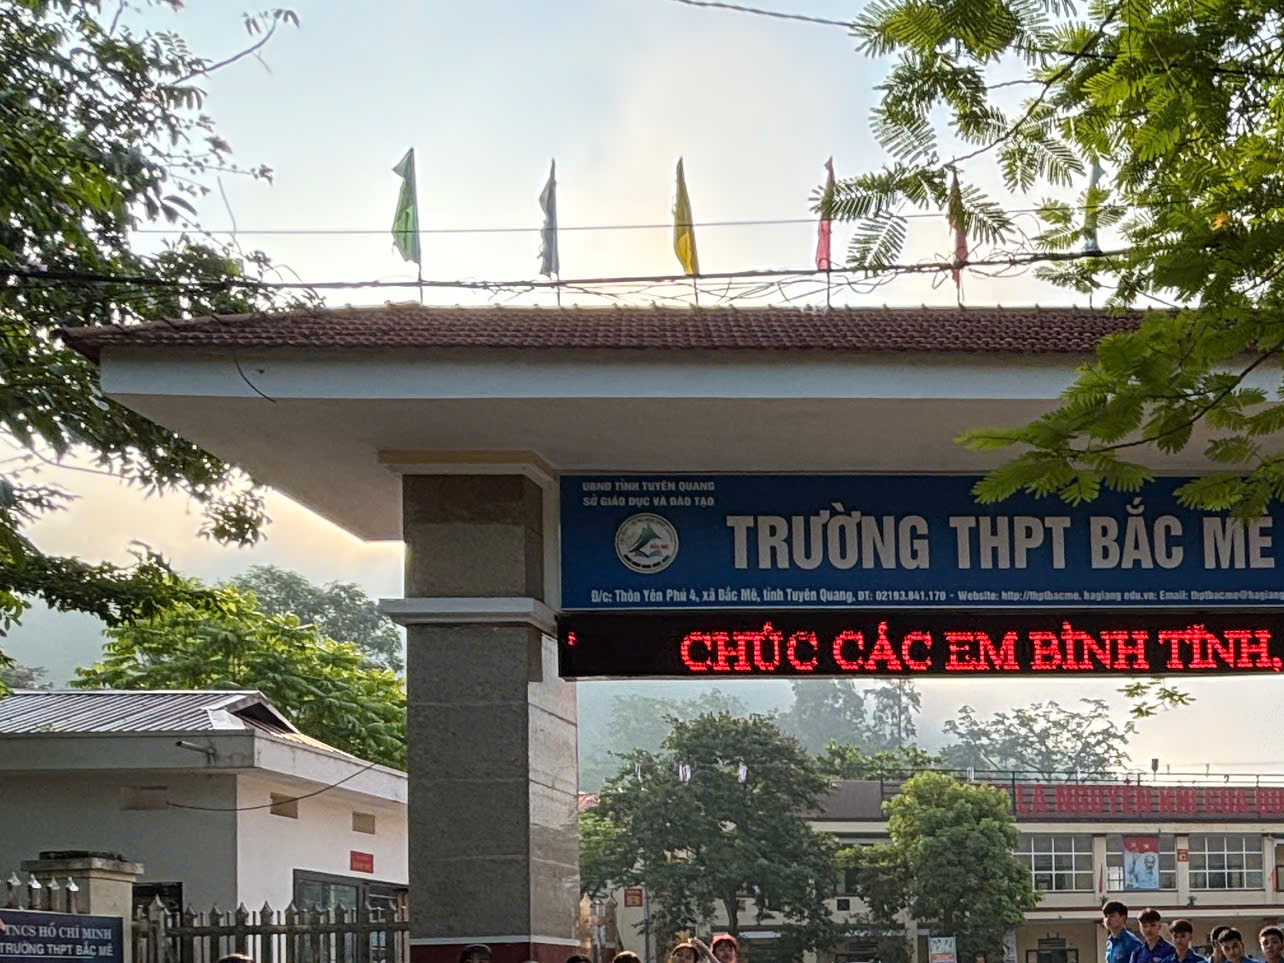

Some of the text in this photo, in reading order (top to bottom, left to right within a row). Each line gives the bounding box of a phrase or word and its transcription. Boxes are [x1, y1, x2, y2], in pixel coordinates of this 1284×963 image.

[582, 481, 612, 491] UBND
[642, 480, 676, 491] TUYÊN
[678, 481, 716, 492] QUANG
[726, 502, 930, 570] TRƯỜNG
[949, 515, 1071, 569] THPT
[1090, 497, 1184, 570] BẮC
[702, 588, 716, 602] xã
[1160, 590, 1189, 601] Email:
[833, 621, 933, 671] CÁC
[944, 631, 1019, 671] EM
[1029, 621, 1149, 670] BÌNH
[5, 922, 112, 939] TNCS HỒ CHÍ MINH
[47, 945, 73, 954] THPT
[76, 942, 97, 955] BẮC
[99, 943, 113, 956] MÊ
